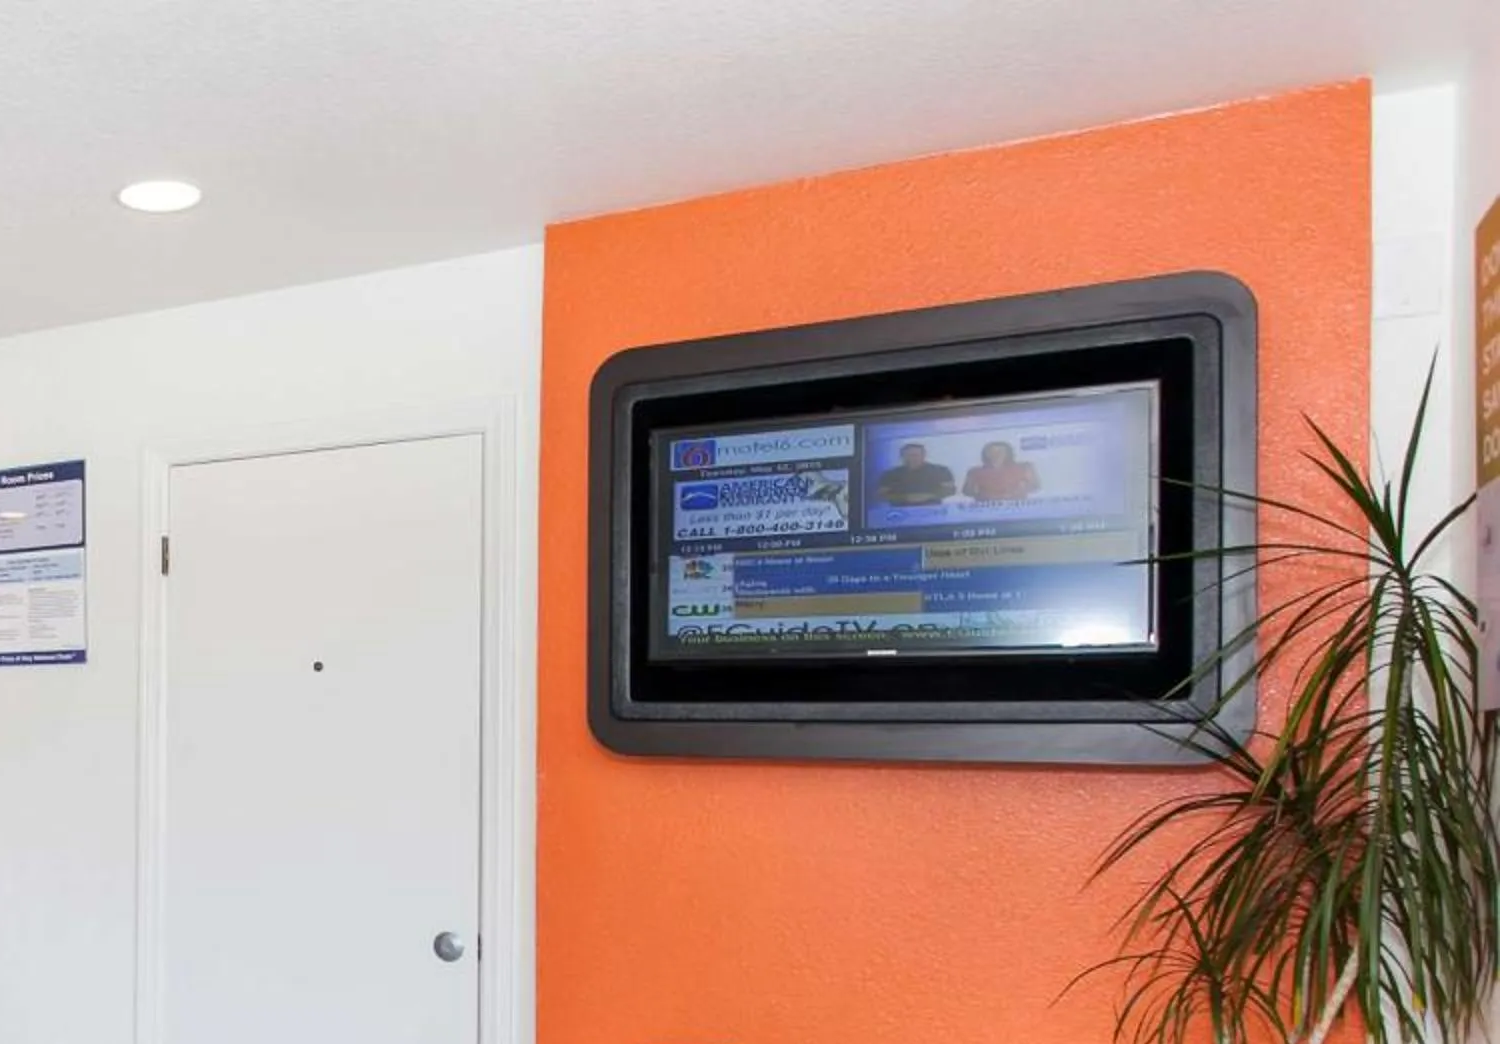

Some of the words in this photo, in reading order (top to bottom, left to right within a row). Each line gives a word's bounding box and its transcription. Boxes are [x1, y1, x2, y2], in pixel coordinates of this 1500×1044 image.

[717, 433, 850, 458] motel6.com
[0, 475, 26, 486] Room
[677, 526, 717, 538] CALL
